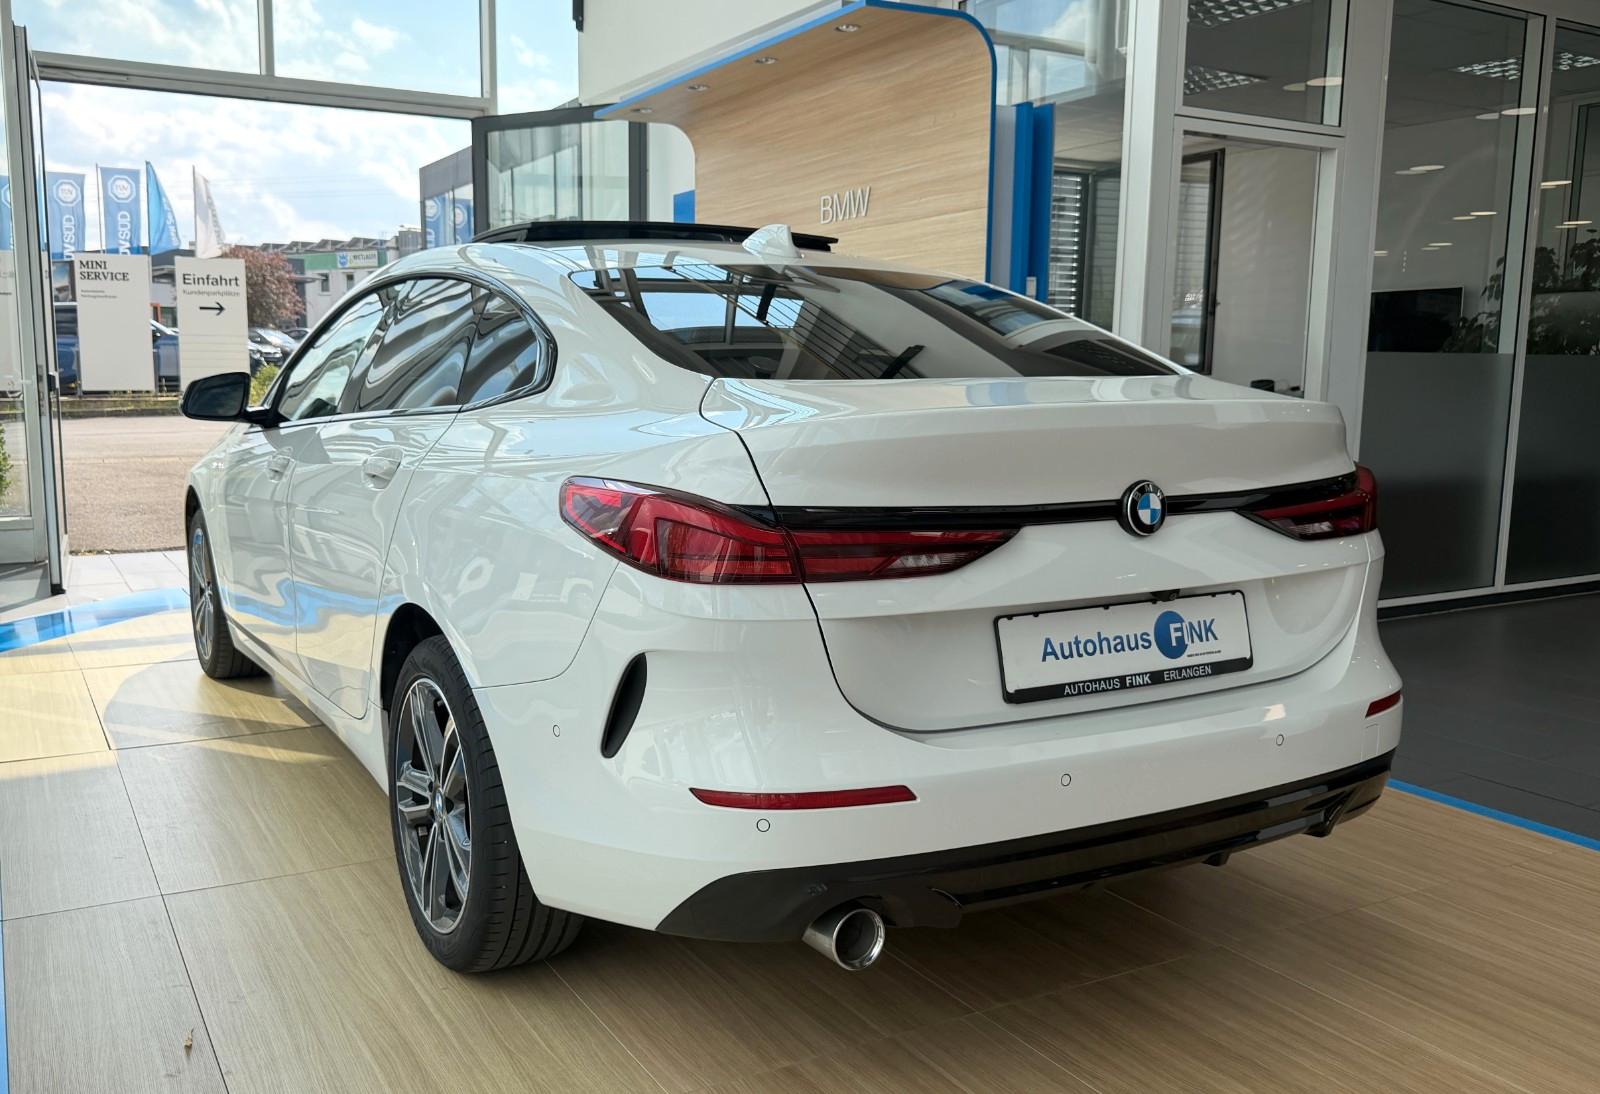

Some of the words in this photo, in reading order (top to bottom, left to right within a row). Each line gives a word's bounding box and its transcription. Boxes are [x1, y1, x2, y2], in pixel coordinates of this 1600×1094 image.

[820, 185, 871, 224] BMW
[79, 260, 107, 270] MINI
[80, 271, 130, 281] SERVICE
[183, 273, 240, 286] Einfahrt
[1132, 484, 1165, 500] BMW
[1041, 631, 1153, 662] Autohaus
[1169, 618, 1219, 647] FINK
[1064, 678, 1120, 696] AUTOHAUS
[1125, 673, 1152, 688] FINK
[1163, 664, 1212, 681] ERLANGEN
